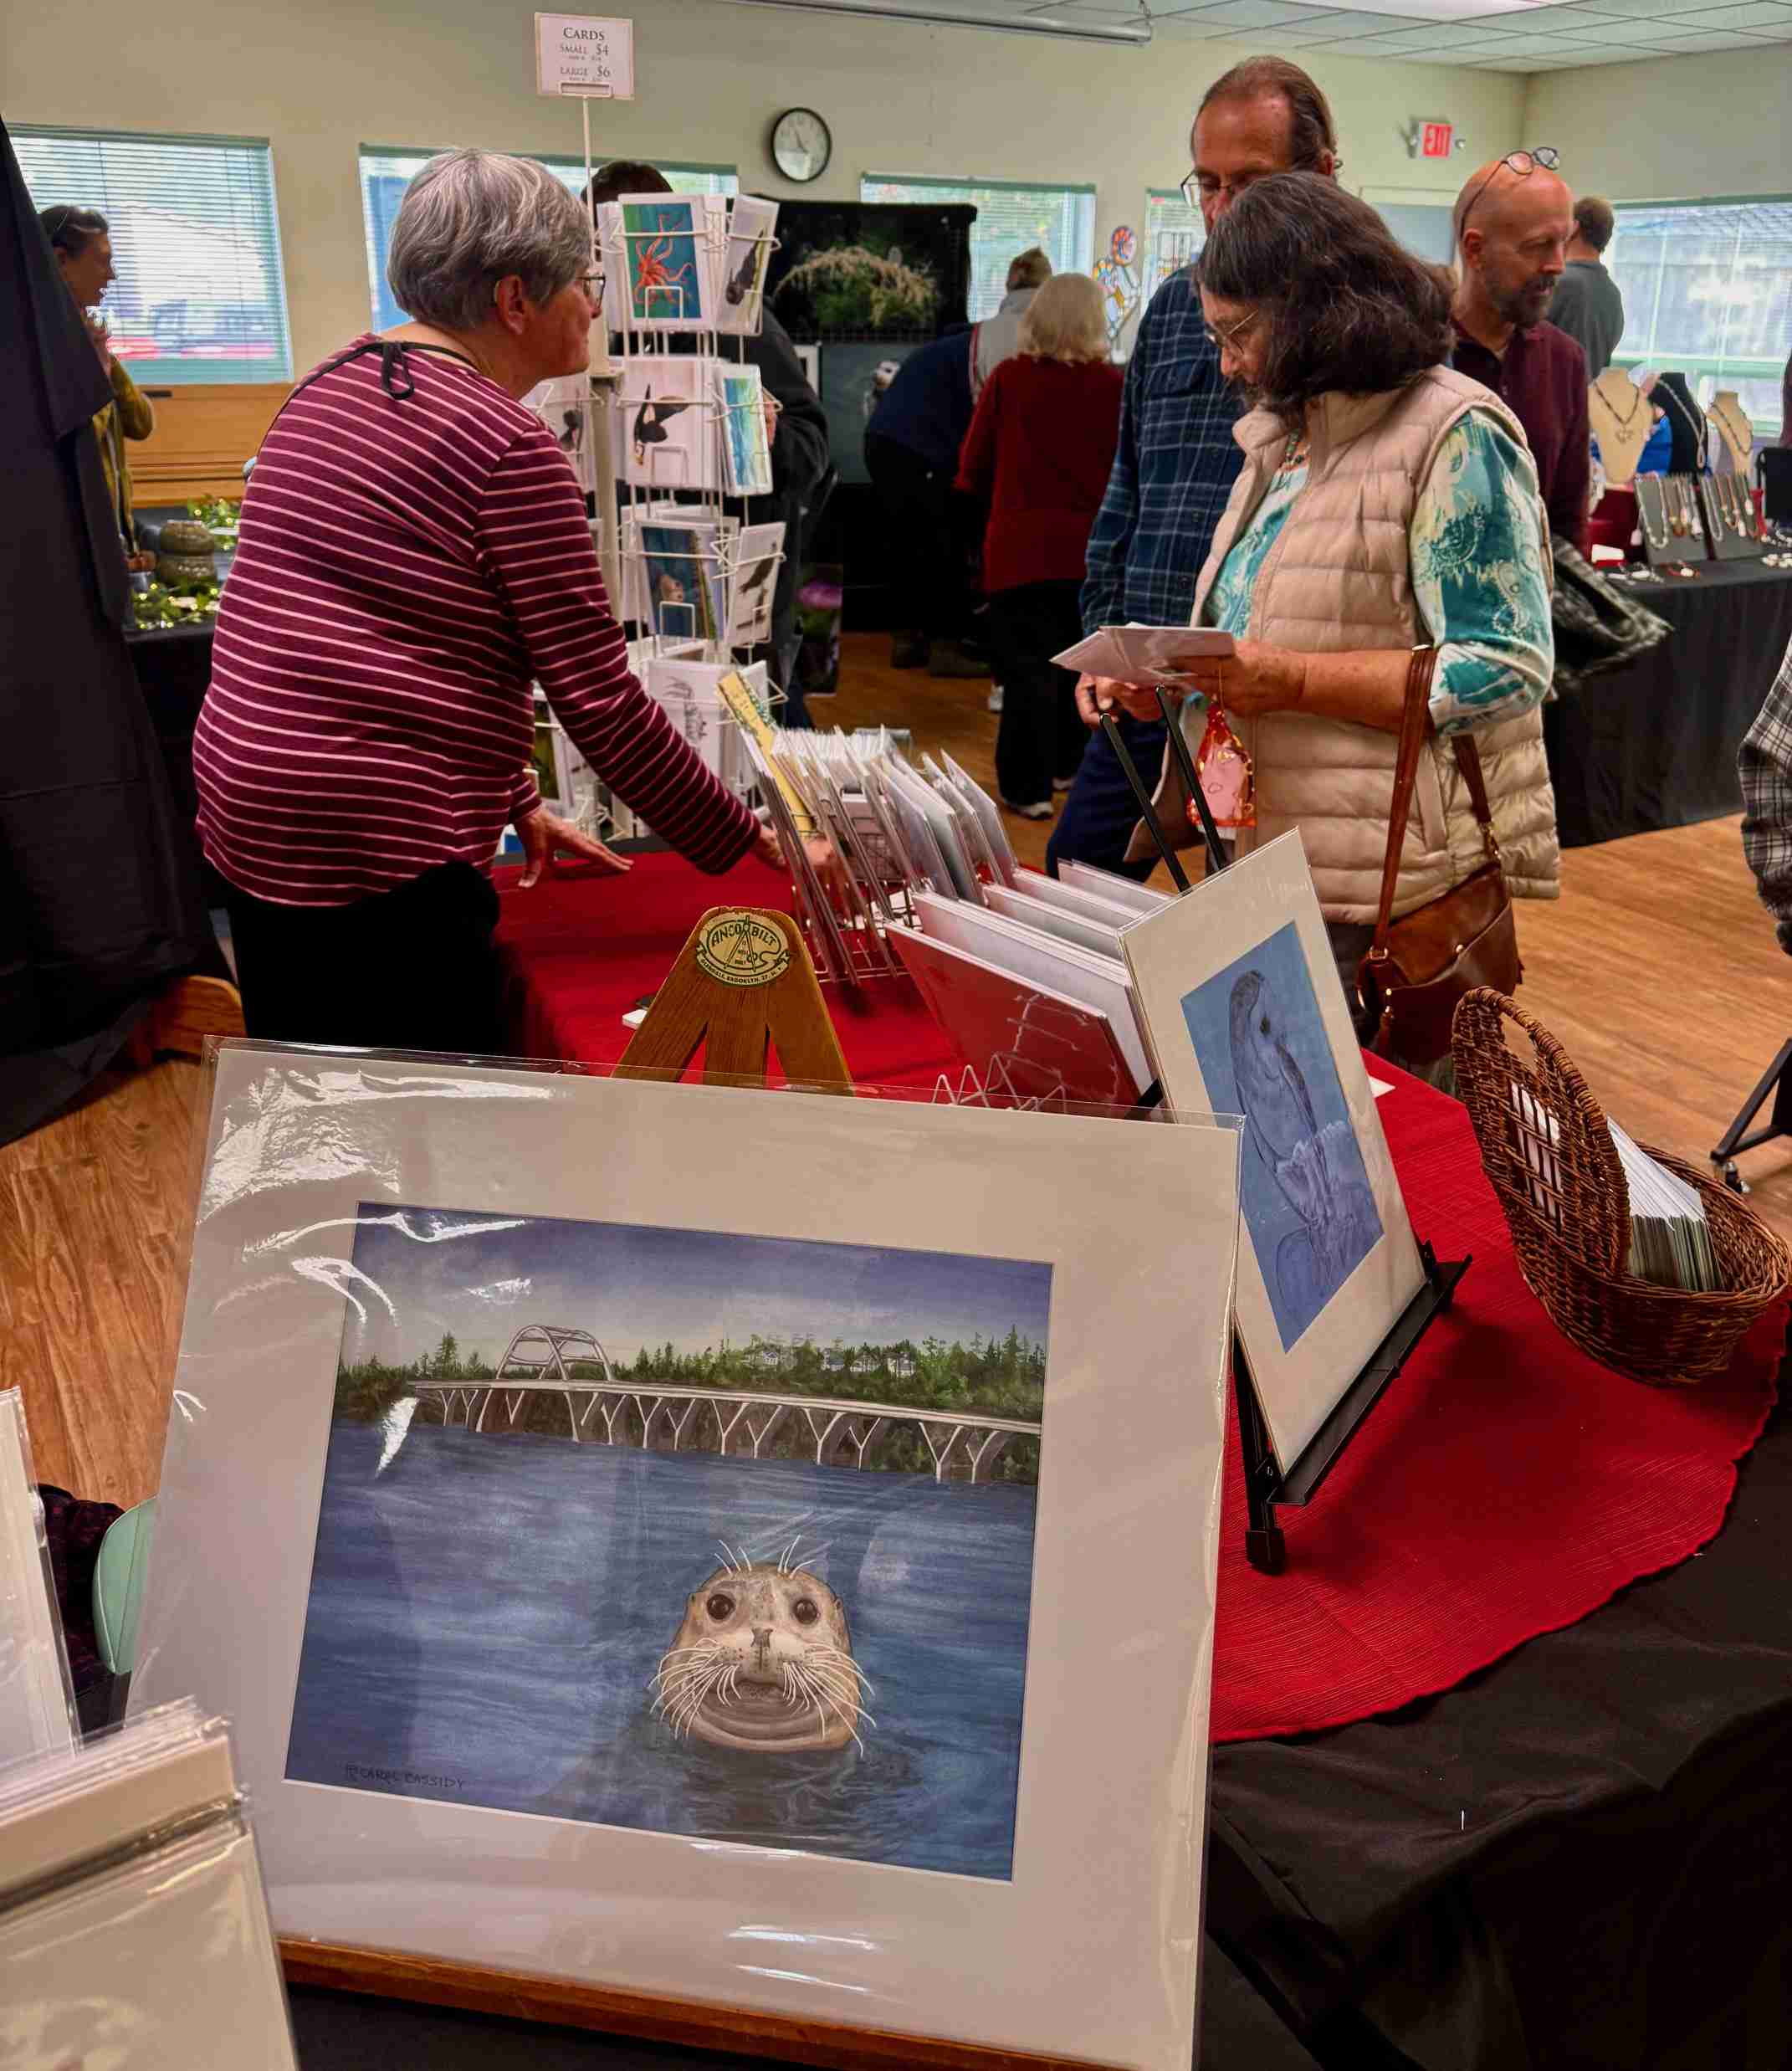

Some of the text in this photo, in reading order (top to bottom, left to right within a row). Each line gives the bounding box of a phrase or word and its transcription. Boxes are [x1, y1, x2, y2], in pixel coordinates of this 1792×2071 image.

[563, 27, 605, 41] CARDS
[559, 44, 609, 55] SMALL $4
[596, 65, 611, 78] $6
[1424, 124, 1452, 156] EXIT
[751, 926, 777, 946] BILT
